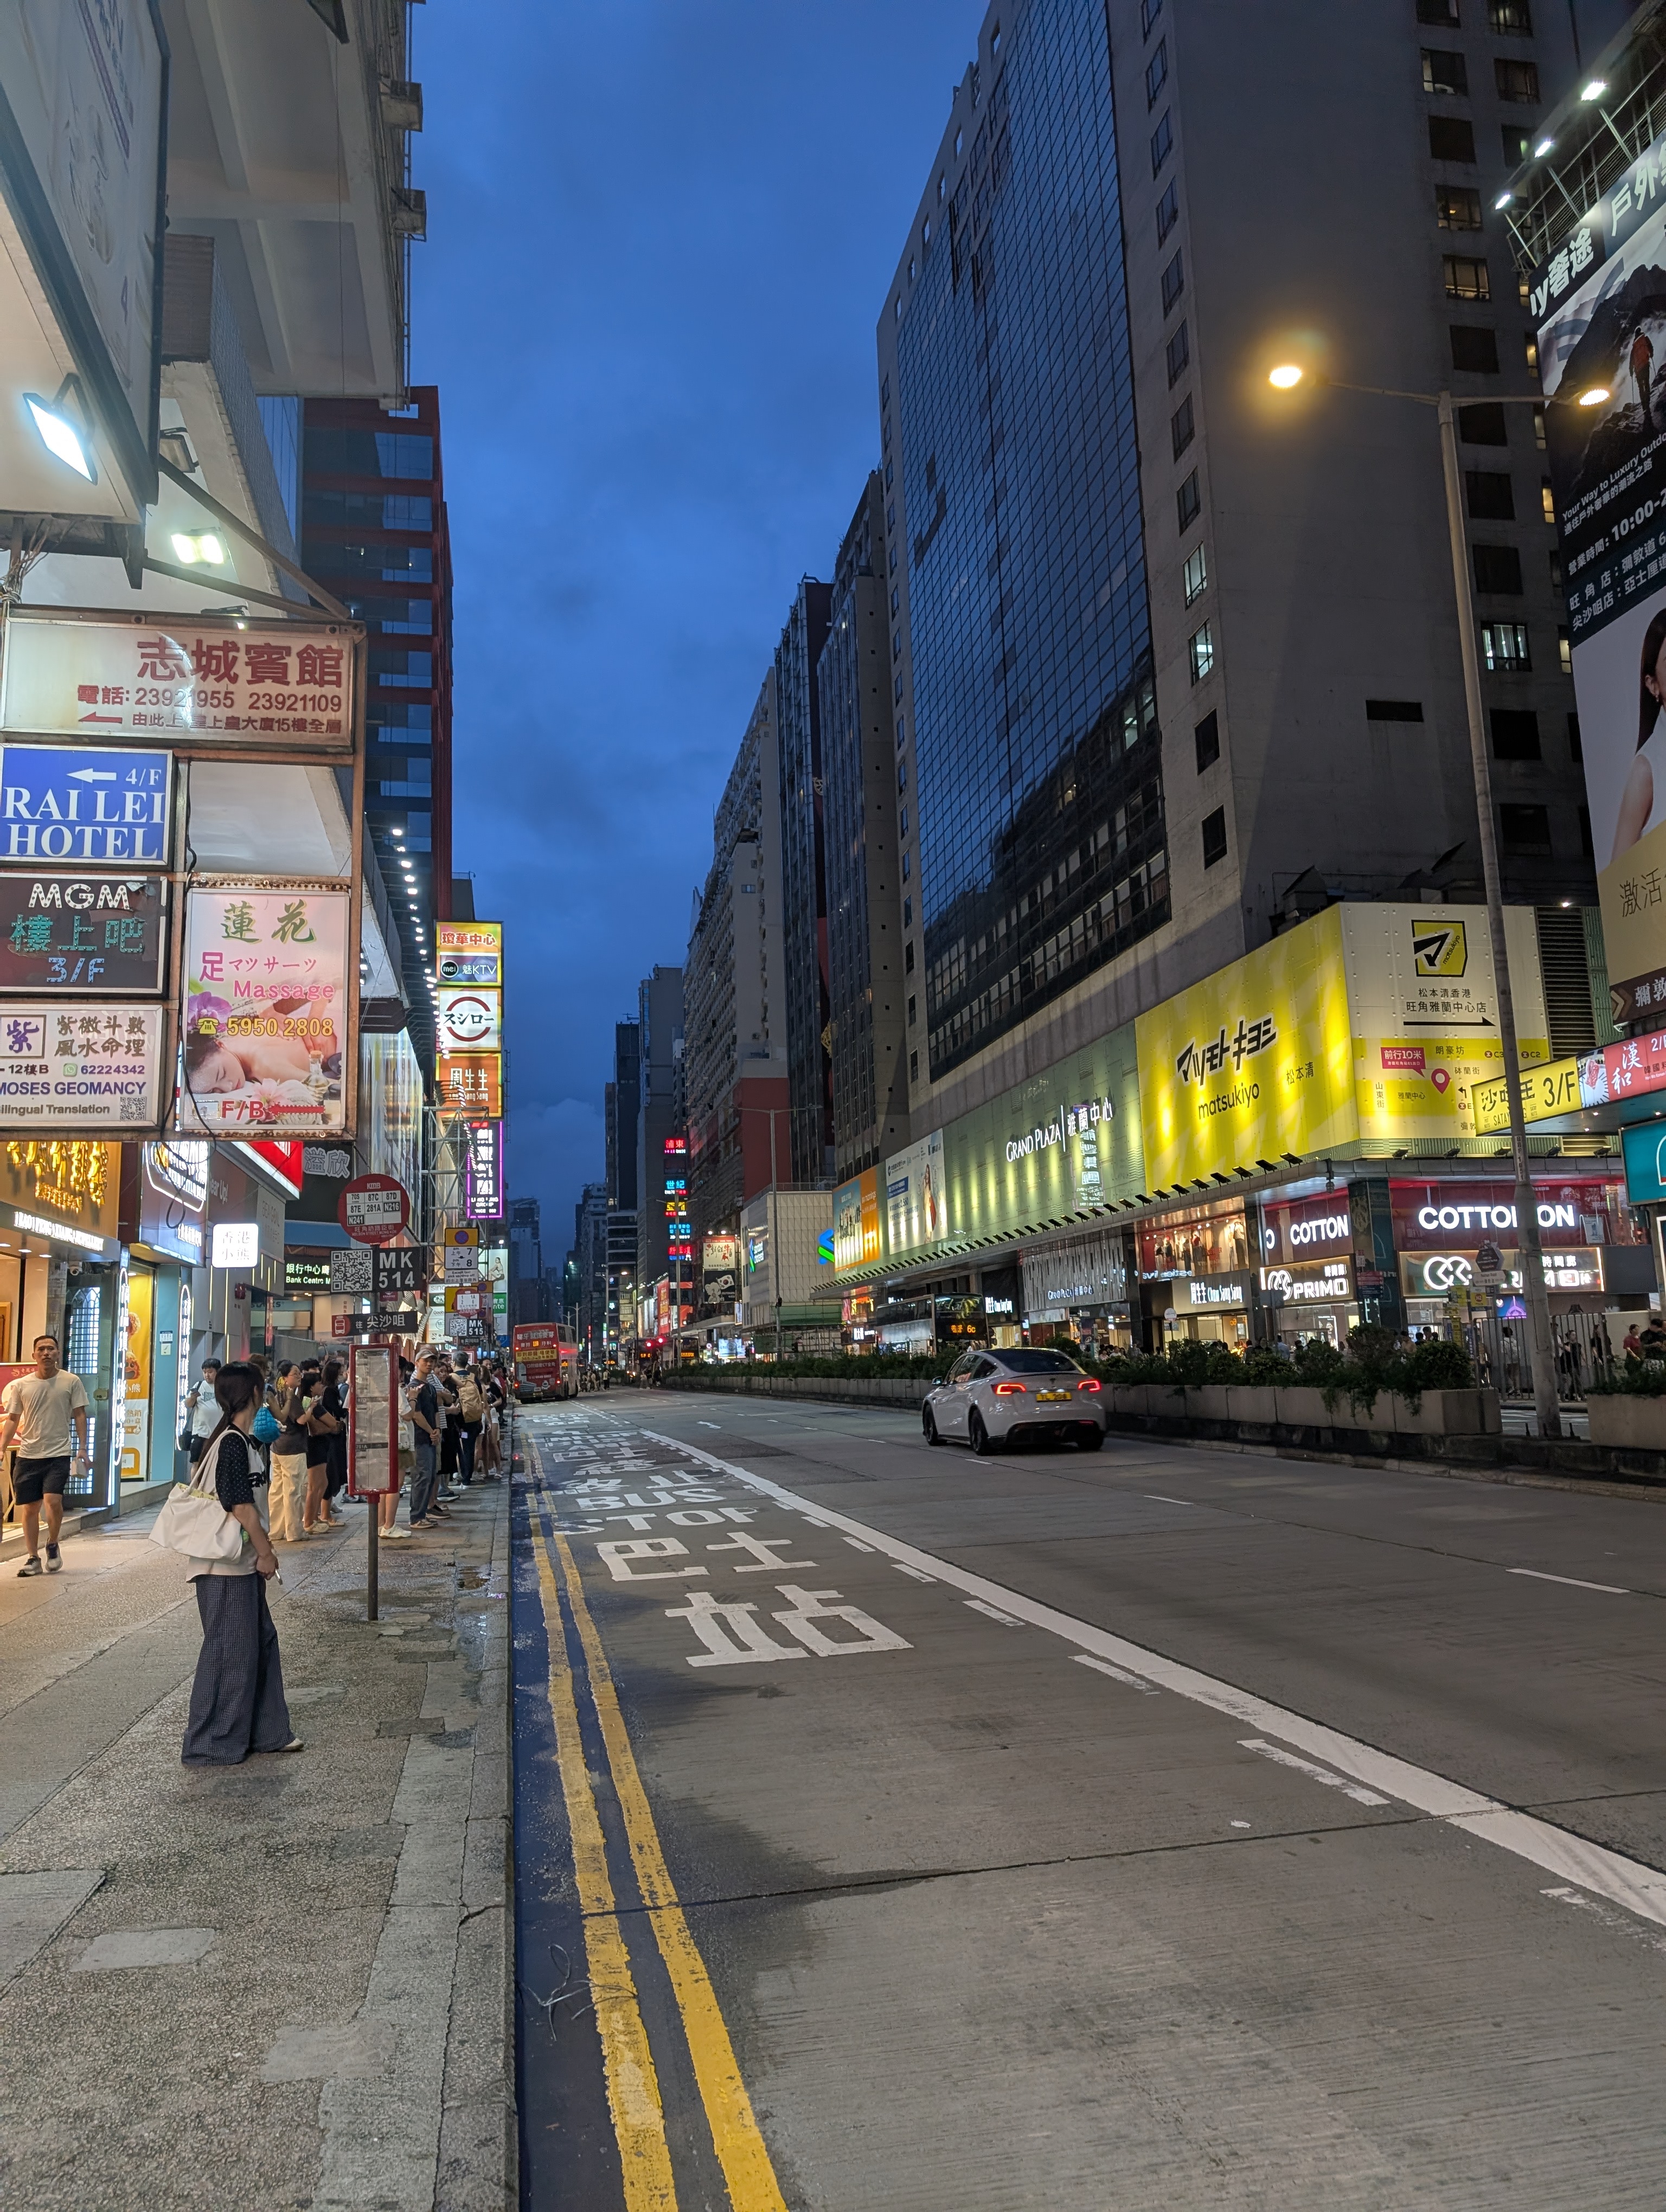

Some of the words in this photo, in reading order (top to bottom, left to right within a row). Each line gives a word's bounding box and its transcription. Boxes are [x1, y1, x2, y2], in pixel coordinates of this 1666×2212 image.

[1562, 502, 1580, 521] Your
[1581, 487, 1598, 506] Way
[1600, 480, 1608, 491] to
[1610, 455, 1638, 484] Luxury
[137, 639, 343, 688] 志城賓館
[78, 684, 130, 705] 電話:
[249, 692, 342, 712] 23921109
[126, 769, 162, 786] 4/F
[7, 824, 158, 860] HOTEL
[28, 883, 130, 910] MGM
[1620, 867, 1662, 917] 激活
[221, 899, 316, 944] 蓮花
[10, 914, 145, 953] 樓上吧
[1442, 934, 1460, 965] matsukiyo
[47, 957, 105, 982] 3/F
[199, 951, 223, 983] 足
[444, 965, 456, 973] mei
[234, 980, 335, 1001] Massage
[1419, 988, 1471, 999] 松本清香港
[1406, 1001, 1486, 1013] 旺角雅蘭中心店
[57, 1015, 146, 1036] 紫微斗數
[227, 1018, 278, 1037] 5950
[283, 1019, 333, 1037] 2808
[444, 1013, 495, 1025] スシロー
[7, 1019, 40, 1053] 紫
[54, 1037, 145, 1058] 風水命理
[1384, 1050, 1422, 1059] 前行10米
[1436, 1046, 1464, 1055] 朗豪坊
[81, 1065, 145, 1075] 62224342
[1286, 1061, 1314, 1085] 松本清
[54, 1082, 146, 1095] GEOMANCY
[477, 1091, 488, 1102] Sang
[1543, 1071, 1575, 1107] 3/F
[0, 1105, 43, 1116] ilingual
[46, 1104, 110, 1114] Translation
[222, 1101, 265, 1120] F/B
[1198, 1082, 1259, 1120] matsukiyo
[1006, 1135, 1034, 1162] GRAND
[1035, 1123, 1061, 1151] PLAZA
[1067, 1097, 1113, 1136] 雅蘭中心
[304, 1147, 350, 1179] 溢欣
[385, 1203, 399, 1211] N216
[1537, 1205, 1575, 1227] ON
[349, 1216, 363, 1224] N241
[1290, 1214, 1349, 1245] COTTON
[286, 1276, 301, 1284] Bank
[379, 1271, 414, 1288] 514
[1294, 1278, 1349, 1300] PRIMO
[1048, 1290, 1060, 1300] GRAND
[1061, 1288, 1073, 1298] PLAZA
[367, 1314, 405, 1328] 尖沙咀
[552, 1447, 649, 1463] 巴士
[576, 1488, 727, 1511] BUS
[553, 1507, 759, 1535] STOP
[595, 1532, 819, 1582] 巴士
[664, 1585, 914, 1667] 站
